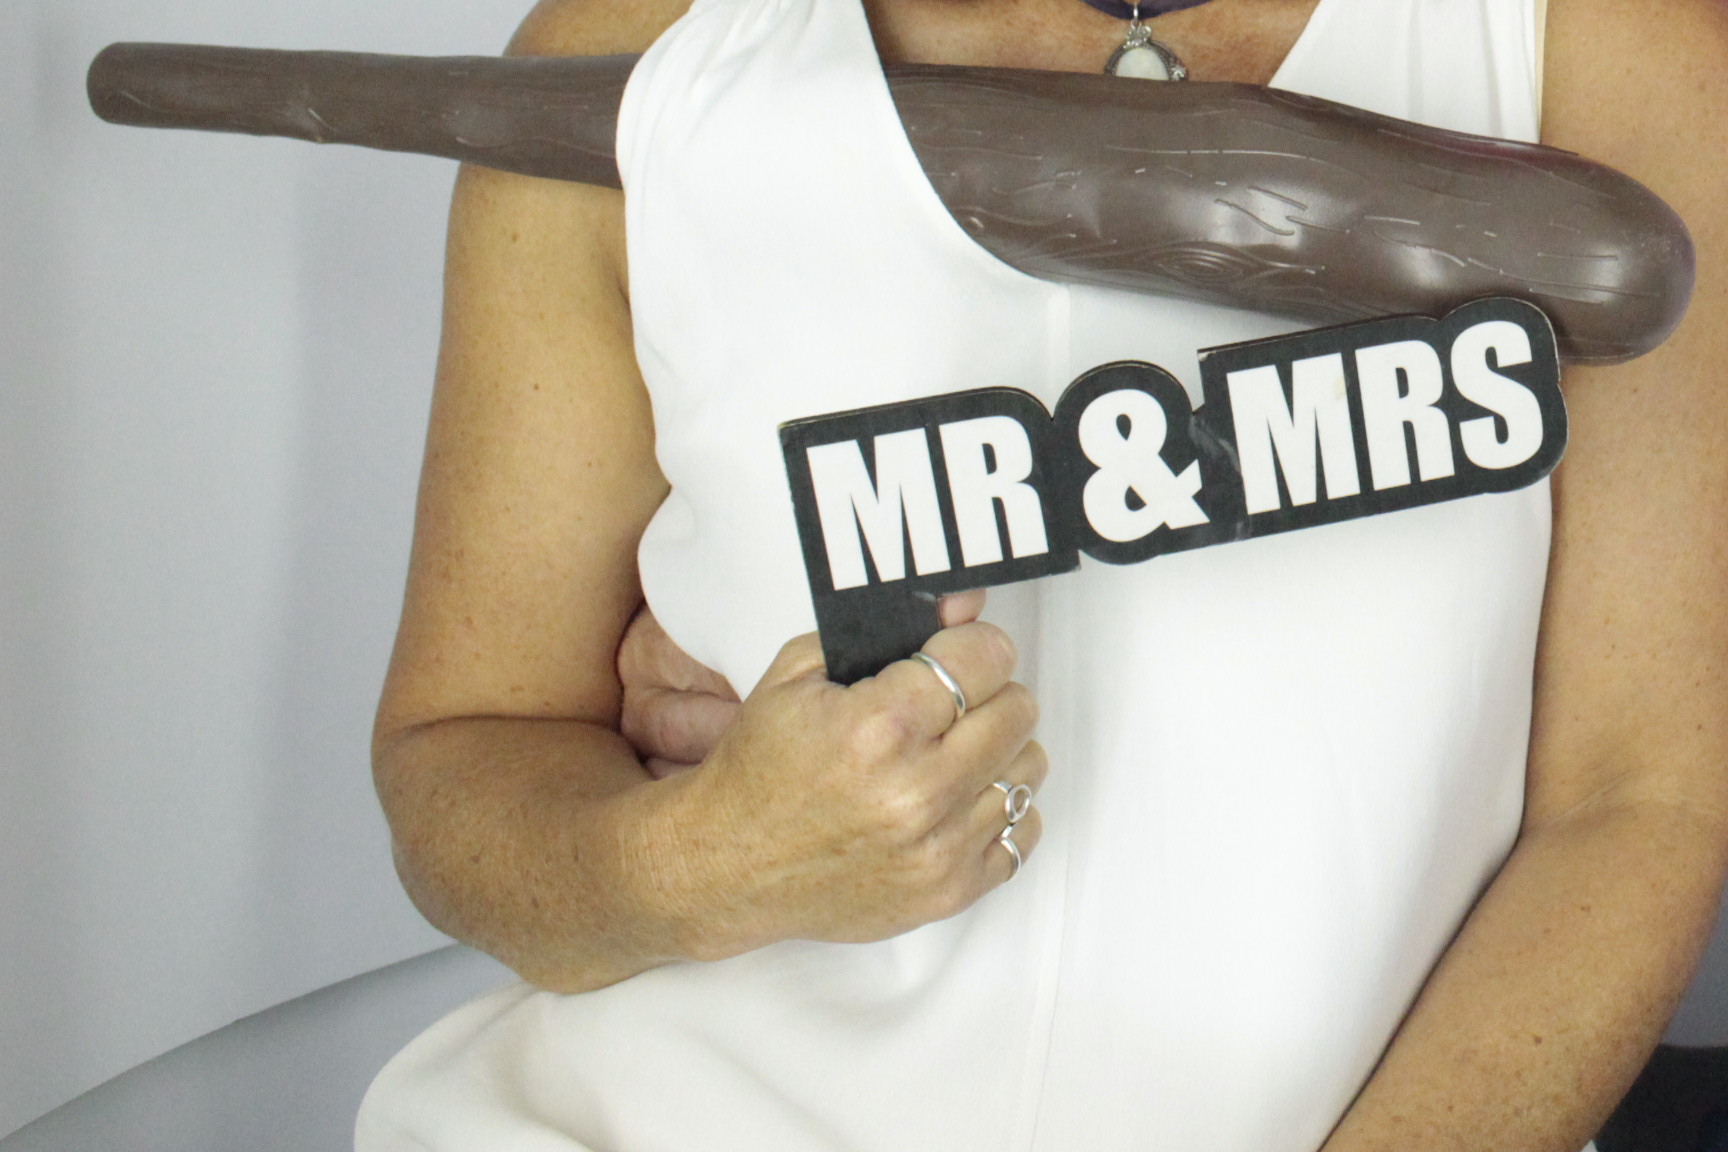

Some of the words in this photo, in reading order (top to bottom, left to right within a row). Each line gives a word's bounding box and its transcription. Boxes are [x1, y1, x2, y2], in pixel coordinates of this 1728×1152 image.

[806, 415, 1049, 591] MR
[1077, 388, 1209, 542] &
[1227, 320, 1544, 516] MRS
